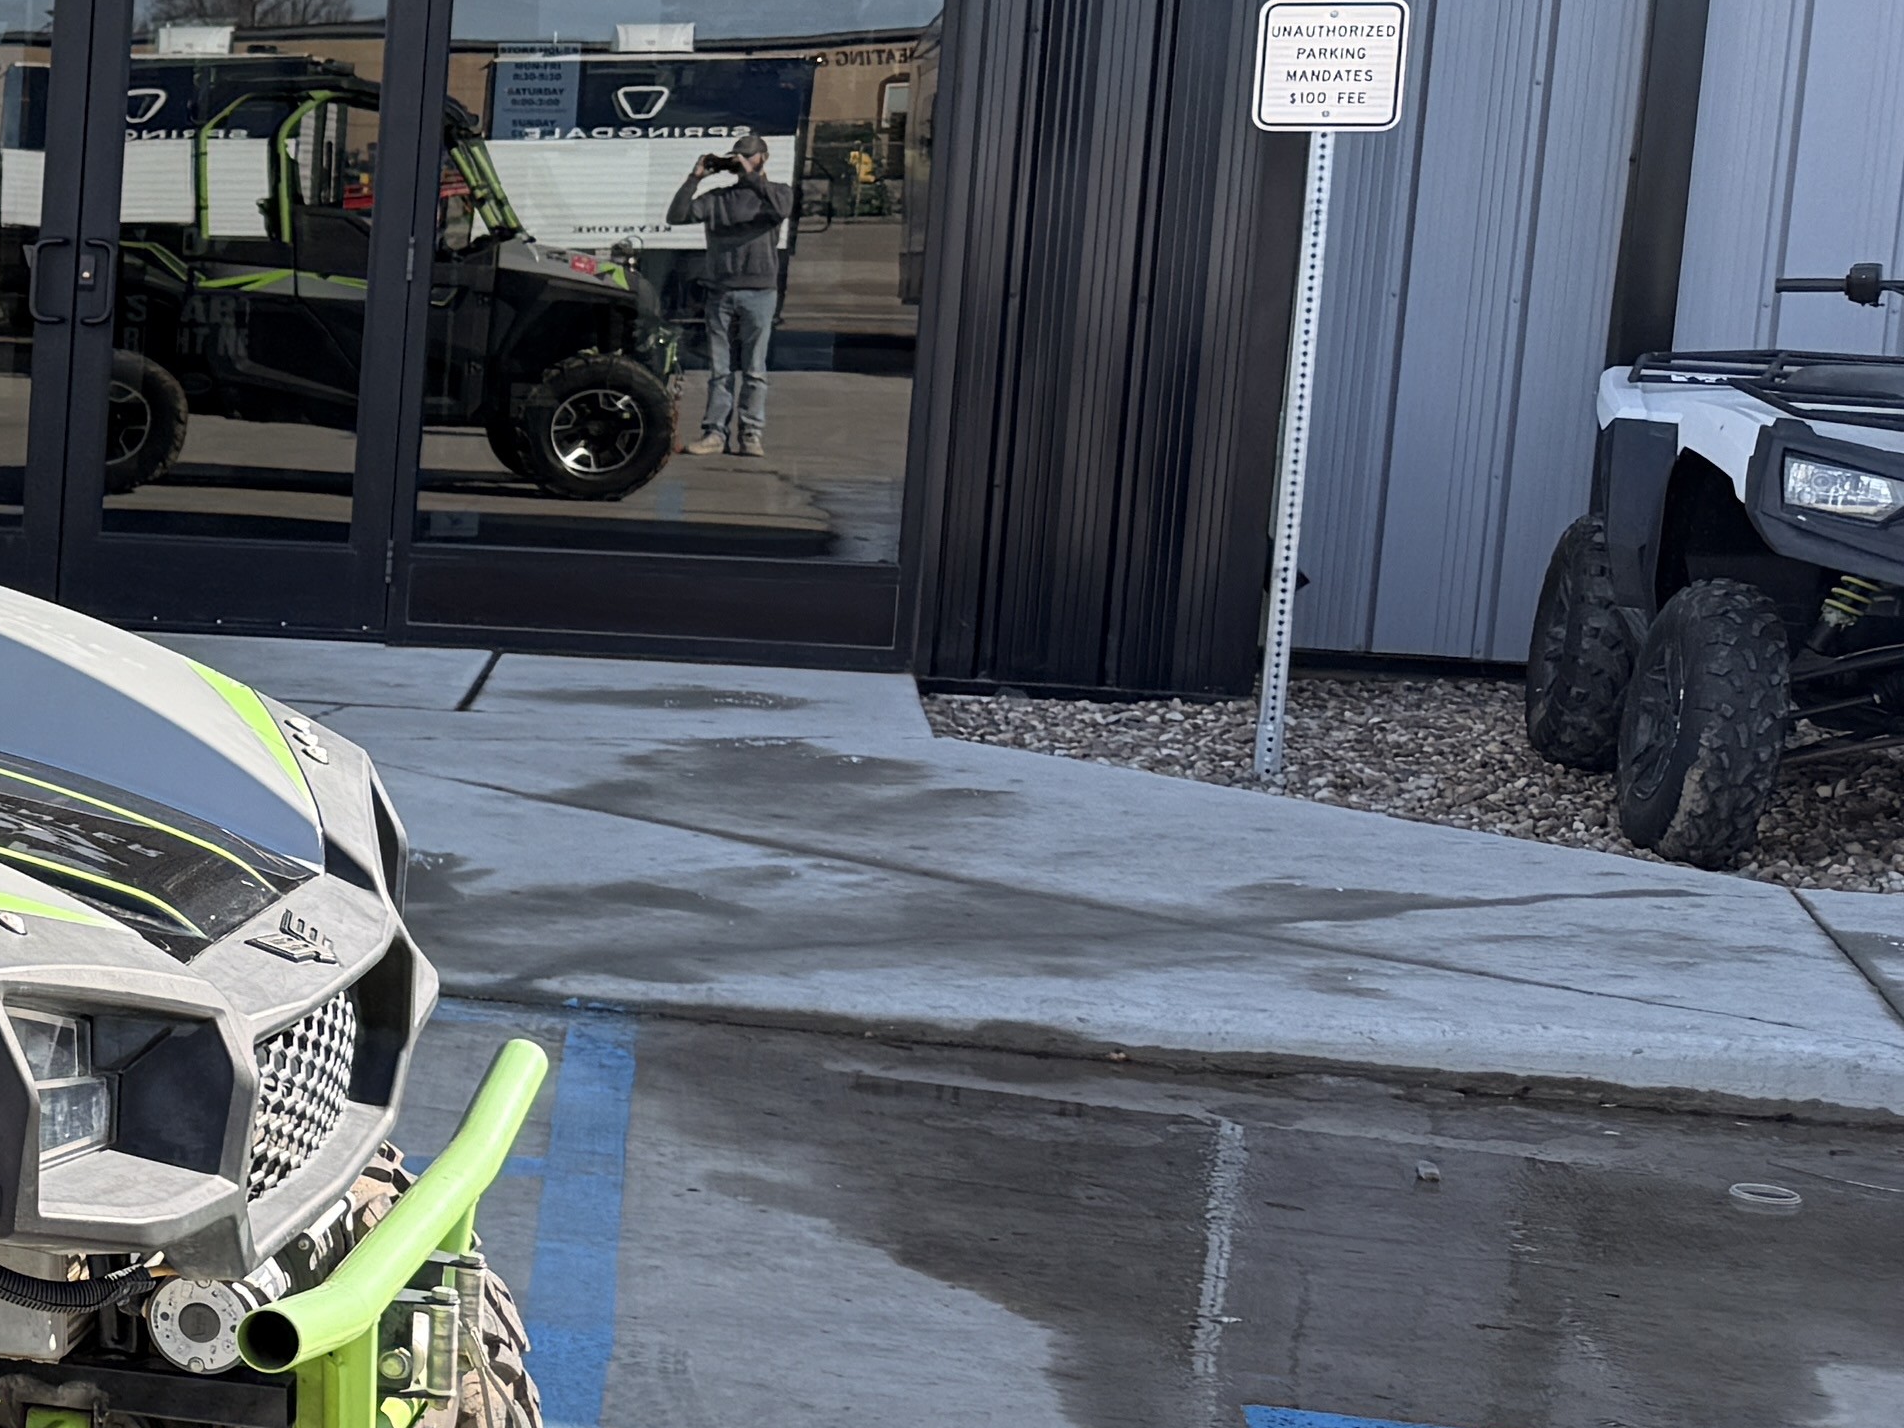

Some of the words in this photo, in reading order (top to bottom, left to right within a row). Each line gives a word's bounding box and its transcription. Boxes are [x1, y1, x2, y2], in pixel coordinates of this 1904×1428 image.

[1271, 25, 1396, 39] UNAUTHORIZED
[1296, 47, 1366, 60] PARKING
[1286, 70, 1373, 83] MANDATES
[1289, 91, 1327, 105] $100
[1337, 91, 1366, 104] FEE
